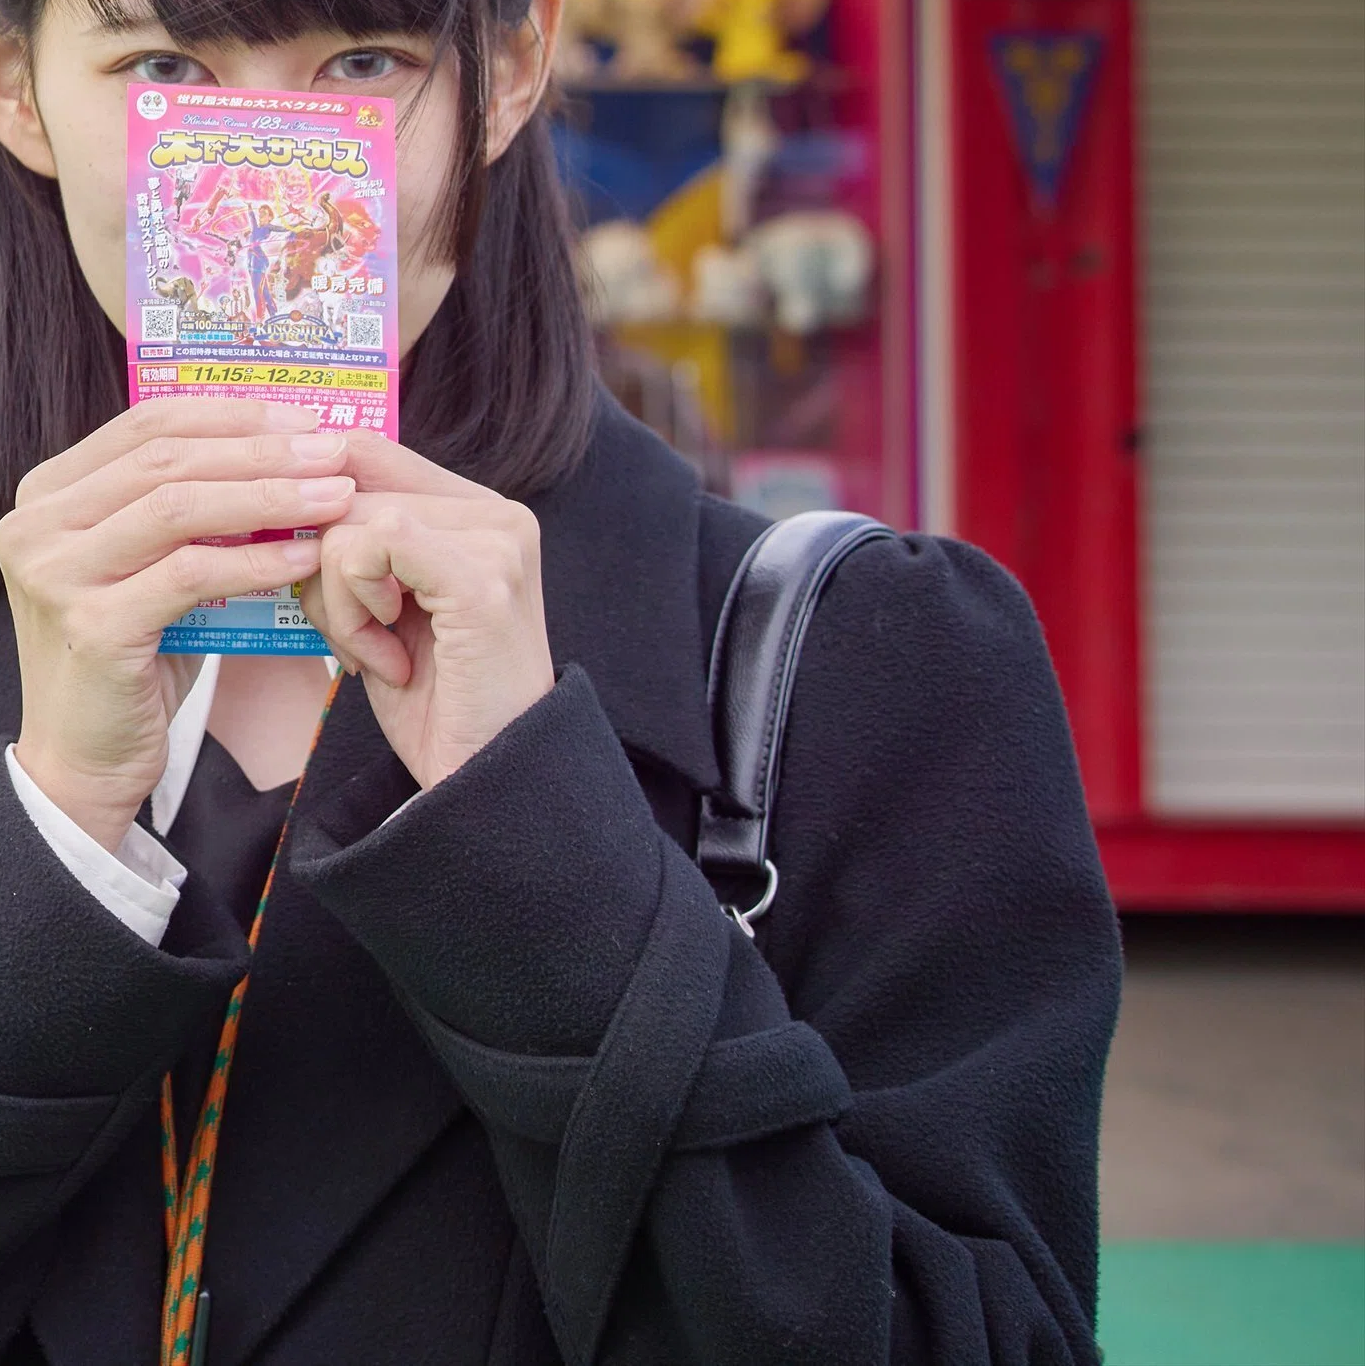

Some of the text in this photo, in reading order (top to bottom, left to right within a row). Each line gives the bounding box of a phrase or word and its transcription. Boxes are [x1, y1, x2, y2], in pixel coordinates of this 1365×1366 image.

[222, 116, 248, 128] Circus
[291, 120, 341, 135] Anniversary
[149, 130, 369, 179] 木下大サーカス
[311, 274, 385, 295] 暖房完備
[255, 323, 336, 340] KINOSHITA
[270, 333, 323, 345] CIRCUS
[142, 348, 171, 356] 転売禁止
[141, 367, 178, 382] 有効期間
